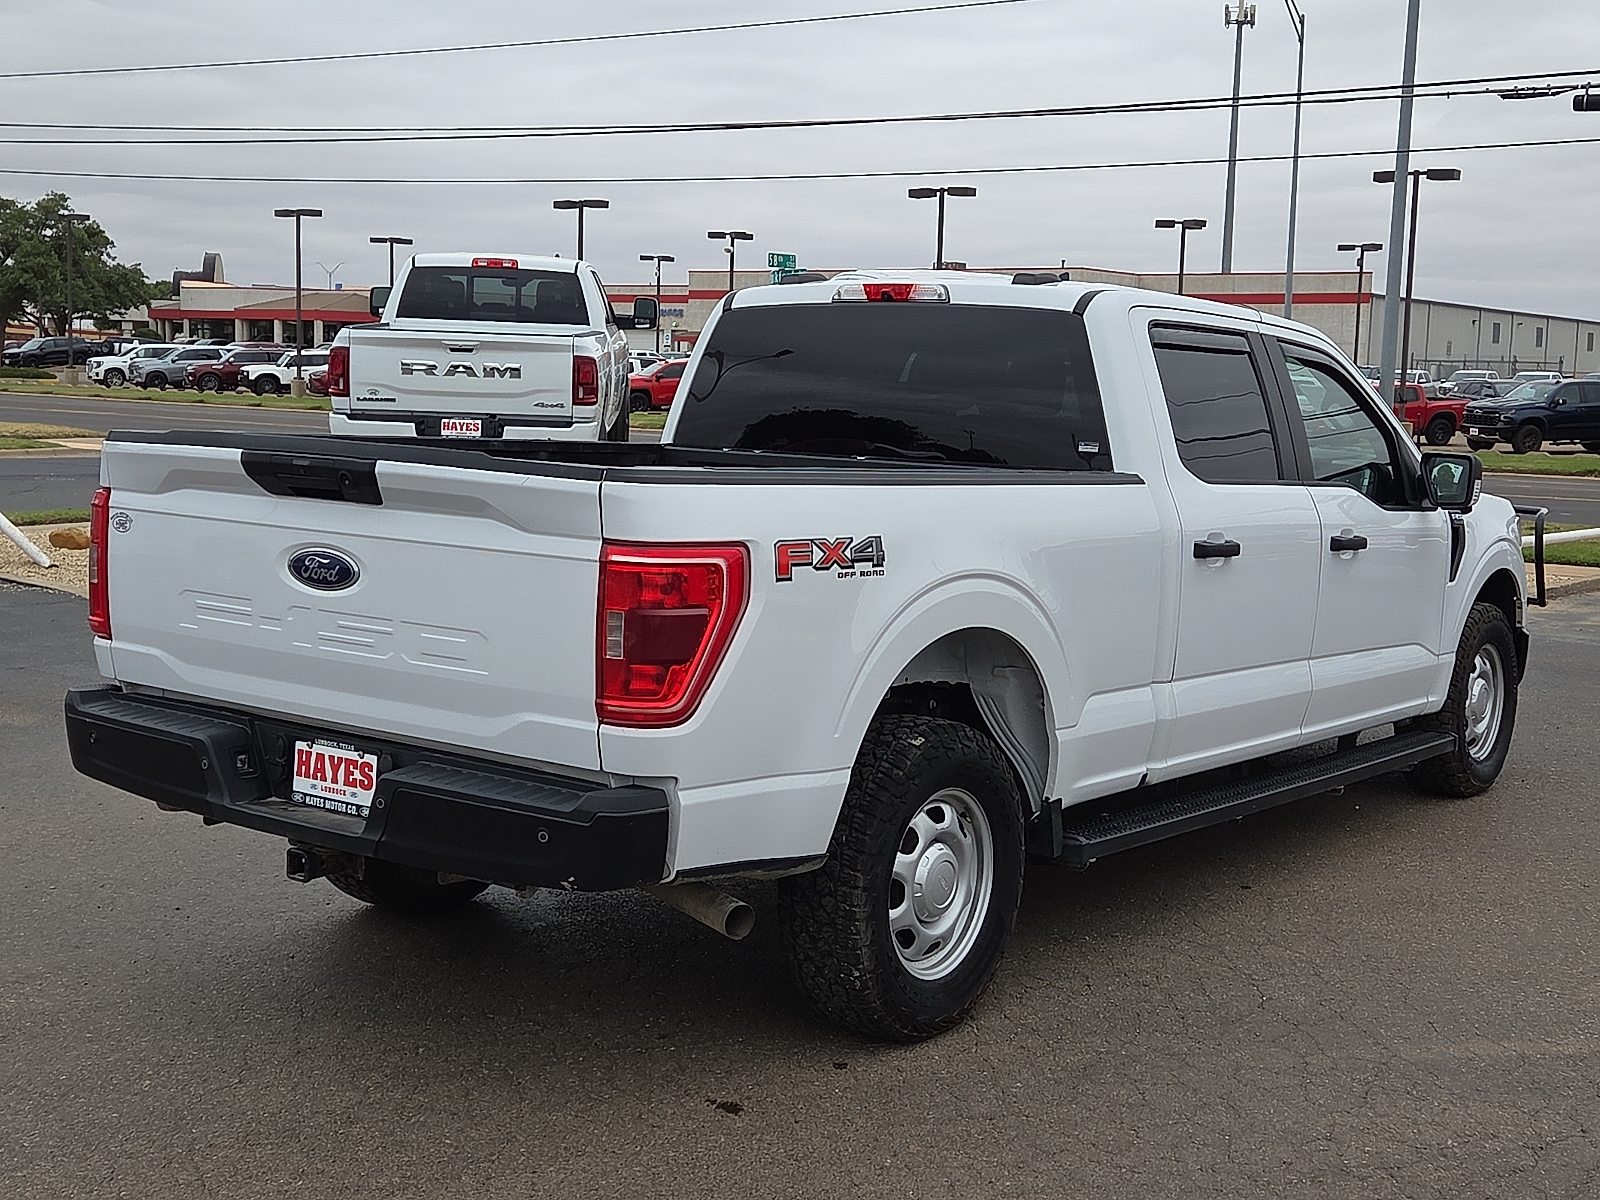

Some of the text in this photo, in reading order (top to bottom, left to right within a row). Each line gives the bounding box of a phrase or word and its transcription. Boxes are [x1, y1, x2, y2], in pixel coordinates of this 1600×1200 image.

[400, 359, 522, 379] RAM
[442, 421, 480, 432] HAYES
[301, 555, 340, 582] Ford
[774, 535, 886, 583] FX4
[837, 569, 885, 579] OFF ROAD
[339, 743, 354, 751] TEXAS
[296, 748, 374, 791] HAYES
[320, 785, 347, 796] LUBBOCK
[305, 796, 358, 815] HAYES MOTOR CO.
